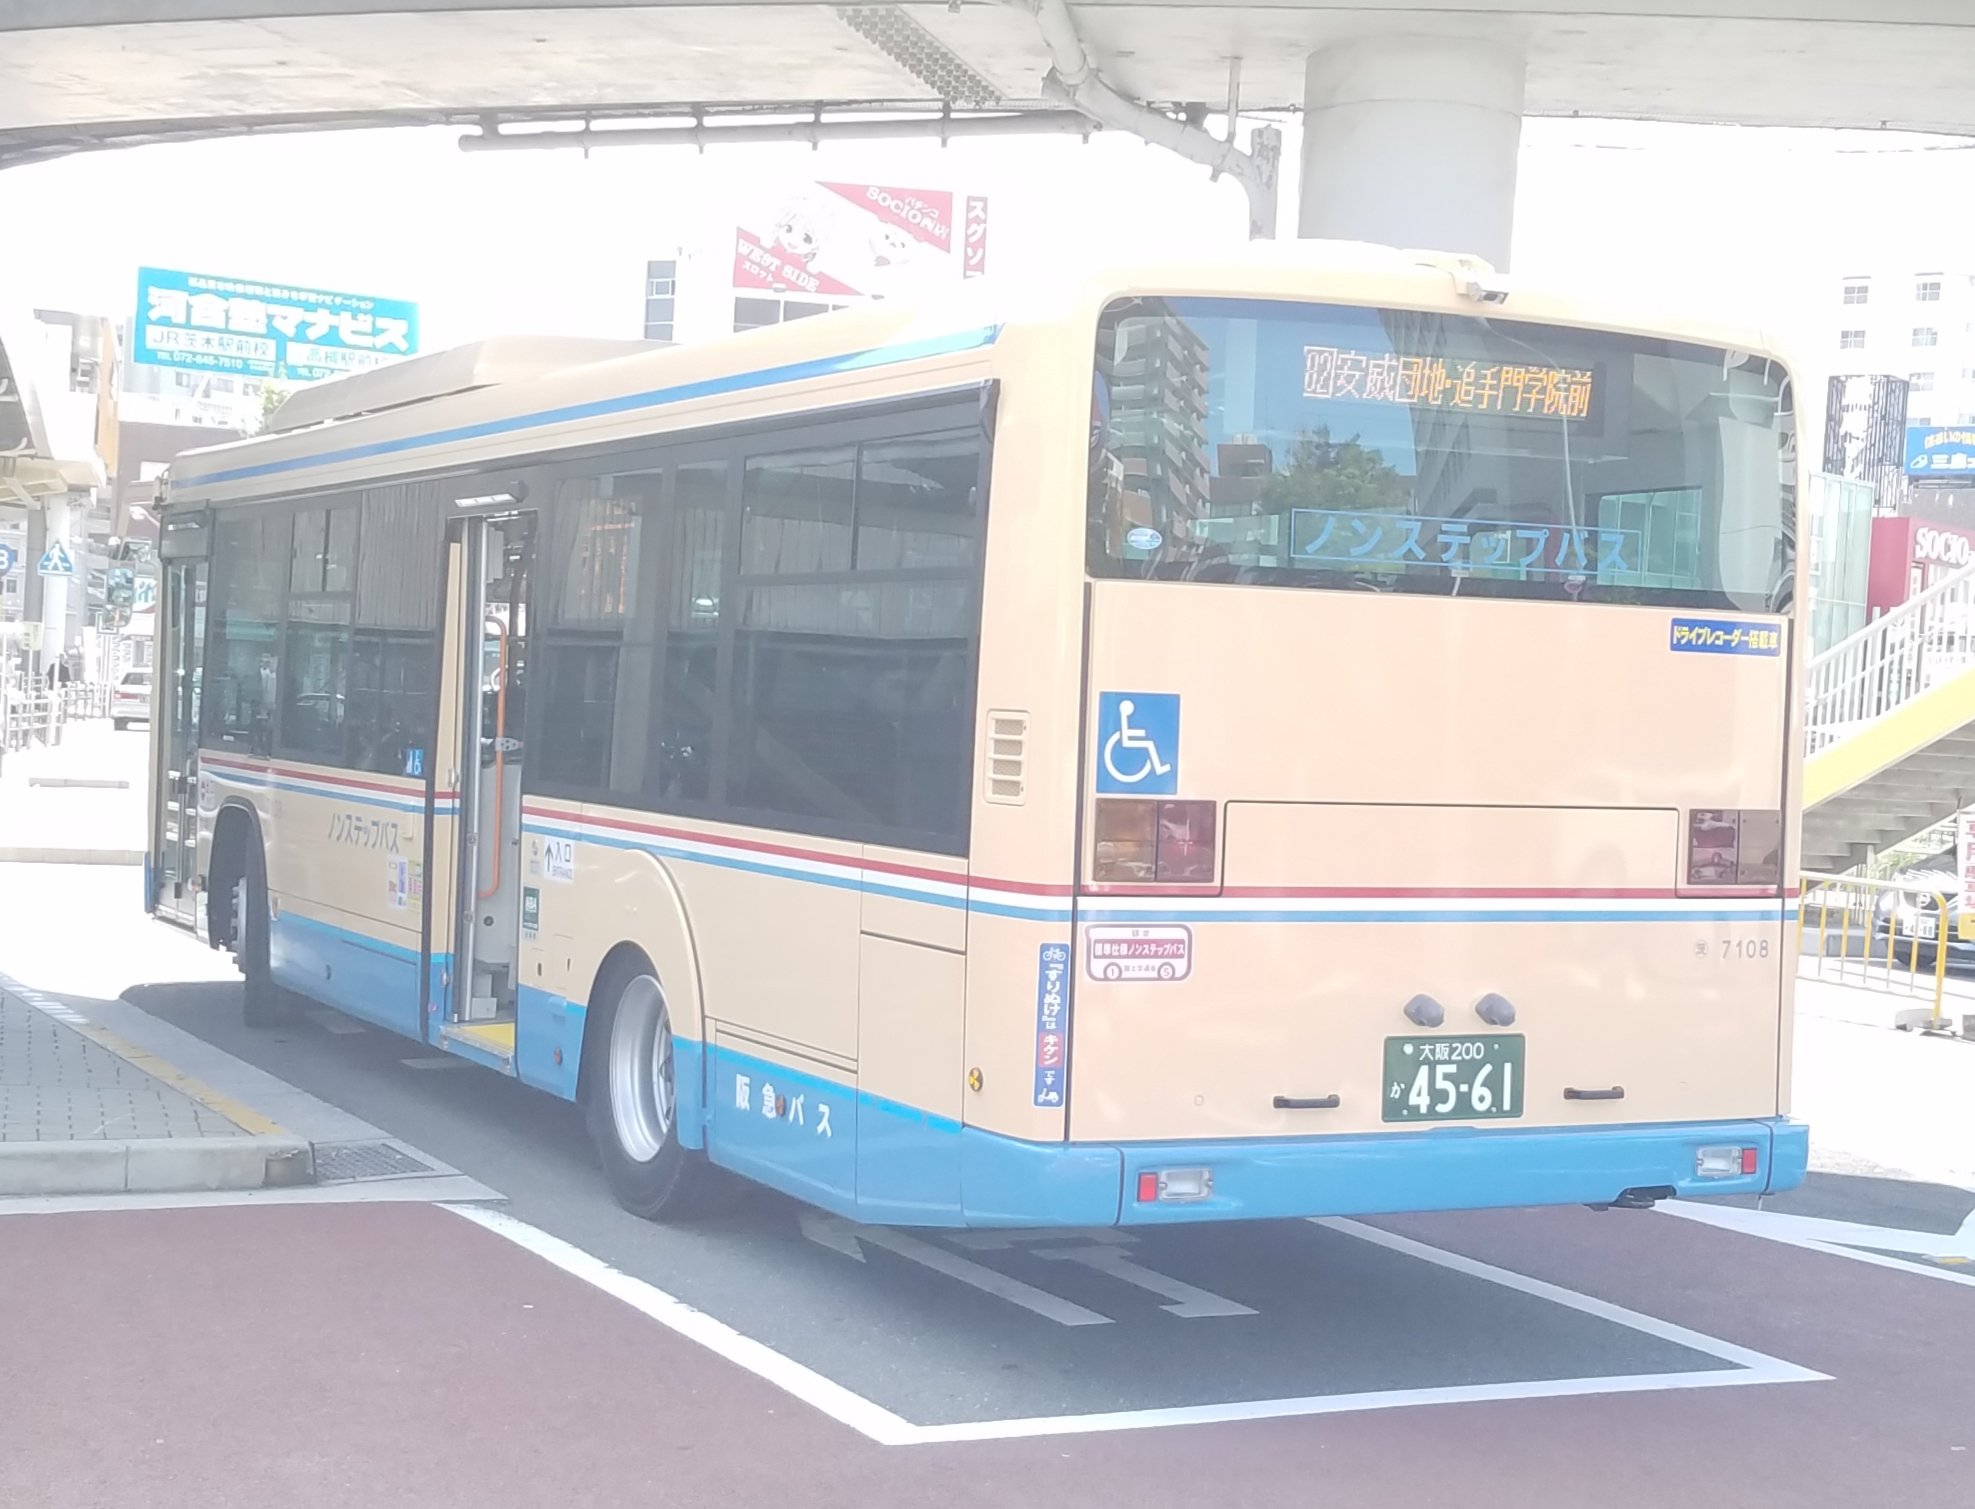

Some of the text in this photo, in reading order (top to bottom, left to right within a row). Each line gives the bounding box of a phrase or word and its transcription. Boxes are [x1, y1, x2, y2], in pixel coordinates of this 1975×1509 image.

[738, 239, 820, 292] WEST SIDE
[742, 260, 775, 282] スロット
[147, 286, 410, 353] 河合塾マナビス
[1304, 516, 1628, 571] ノンステップバス
[328, 812, 399, 854] ノンステップバス
[555, 841, 572, 863] 入口
[1722, 938, 1769, 960] 7108
[736, 1073, 832, 1139] 阪急バス
[1390, 1062, 1512, 1114] か 45-61
